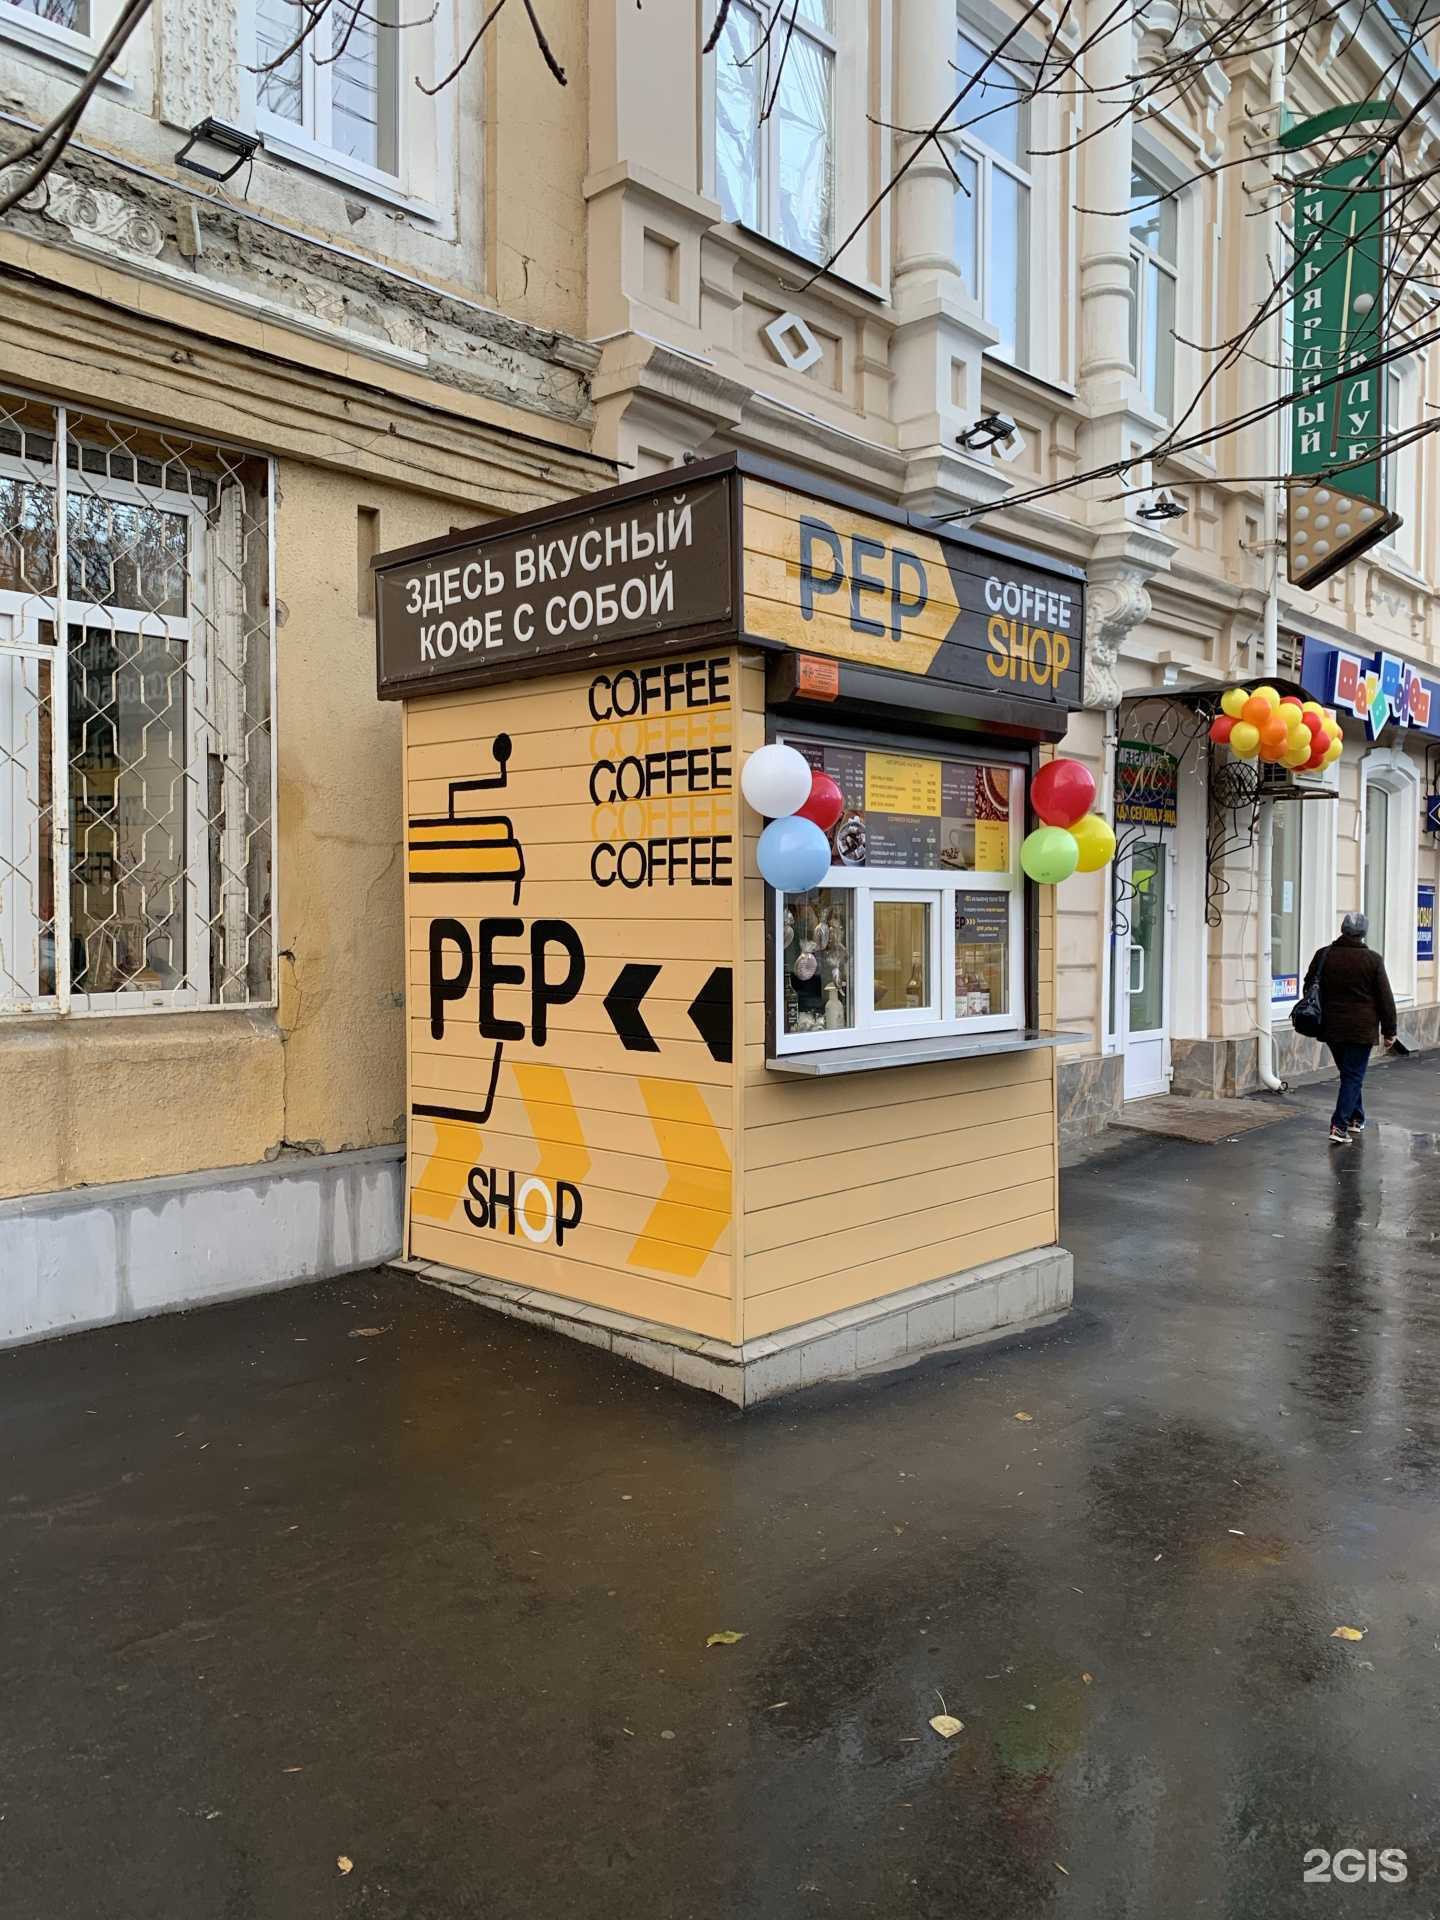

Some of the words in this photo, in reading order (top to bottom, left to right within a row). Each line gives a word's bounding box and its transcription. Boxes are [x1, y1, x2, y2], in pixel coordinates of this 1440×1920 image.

[405, 559, 505, 618] ЗДЕСЬ
[514, 494, 693, 589] ВКУСНЫЙ
[799, 514, 929, 642] PEP
[420, 609, 503, 662] КОФЕ
[513, 603, 535, 642] С
[545, 559, 674, 636] СОБОЙ
[984, 576, 1071, 629] COFFEE
[985, 614, 1070, 689] SHOP
[588, 657, 731, 721] COFFEE
[589, 704, 732, 761] COFFEE
[589, 745, 732, 806] COFFEE
[591, 792, 732, 842] COFFEE
[590, 835, 733, 889] COFFEE
[429, 918, 586, 1047] PEP
[463, 1167, 583, 1247] SHOP
